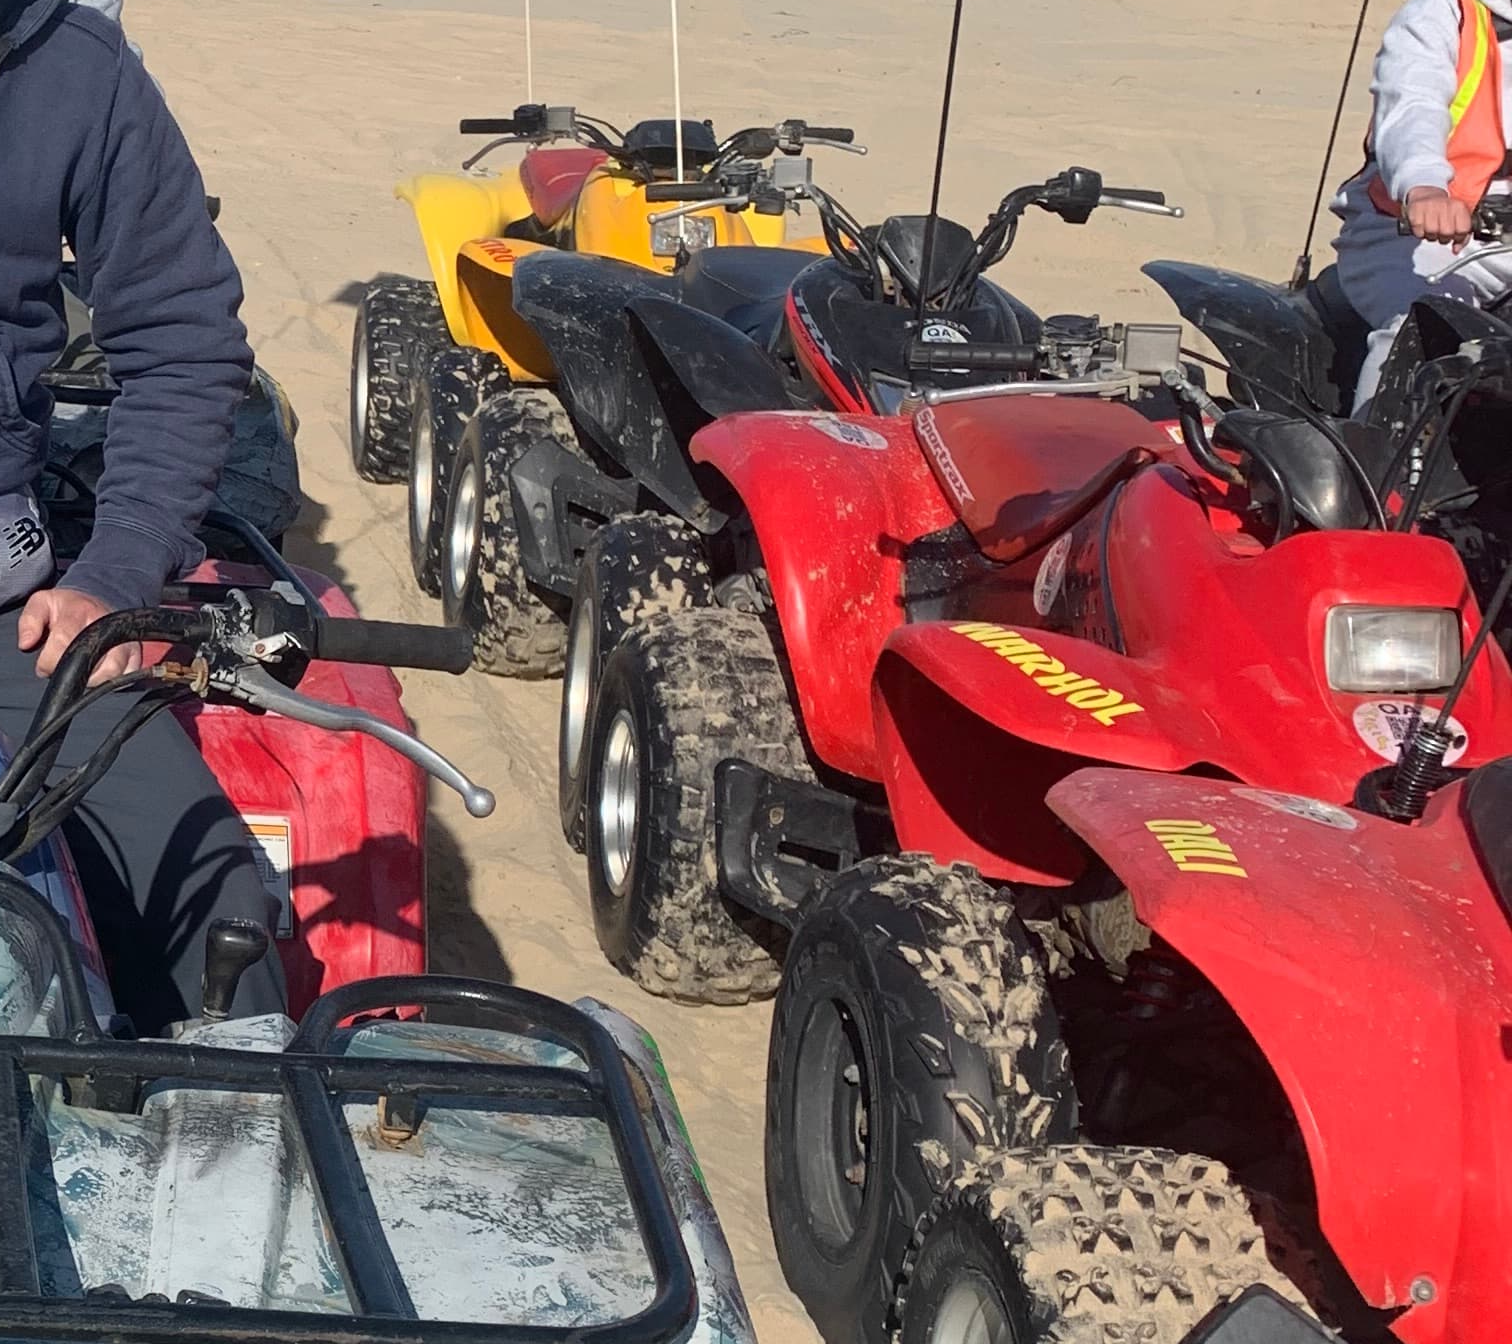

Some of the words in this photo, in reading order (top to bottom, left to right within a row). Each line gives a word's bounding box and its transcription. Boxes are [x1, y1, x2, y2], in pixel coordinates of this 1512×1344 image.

[917, 408, 975, 504] Sportrax
[948, 622, 1145, 727] WARHOL
[1143, 819, 1249, 879] DALI
